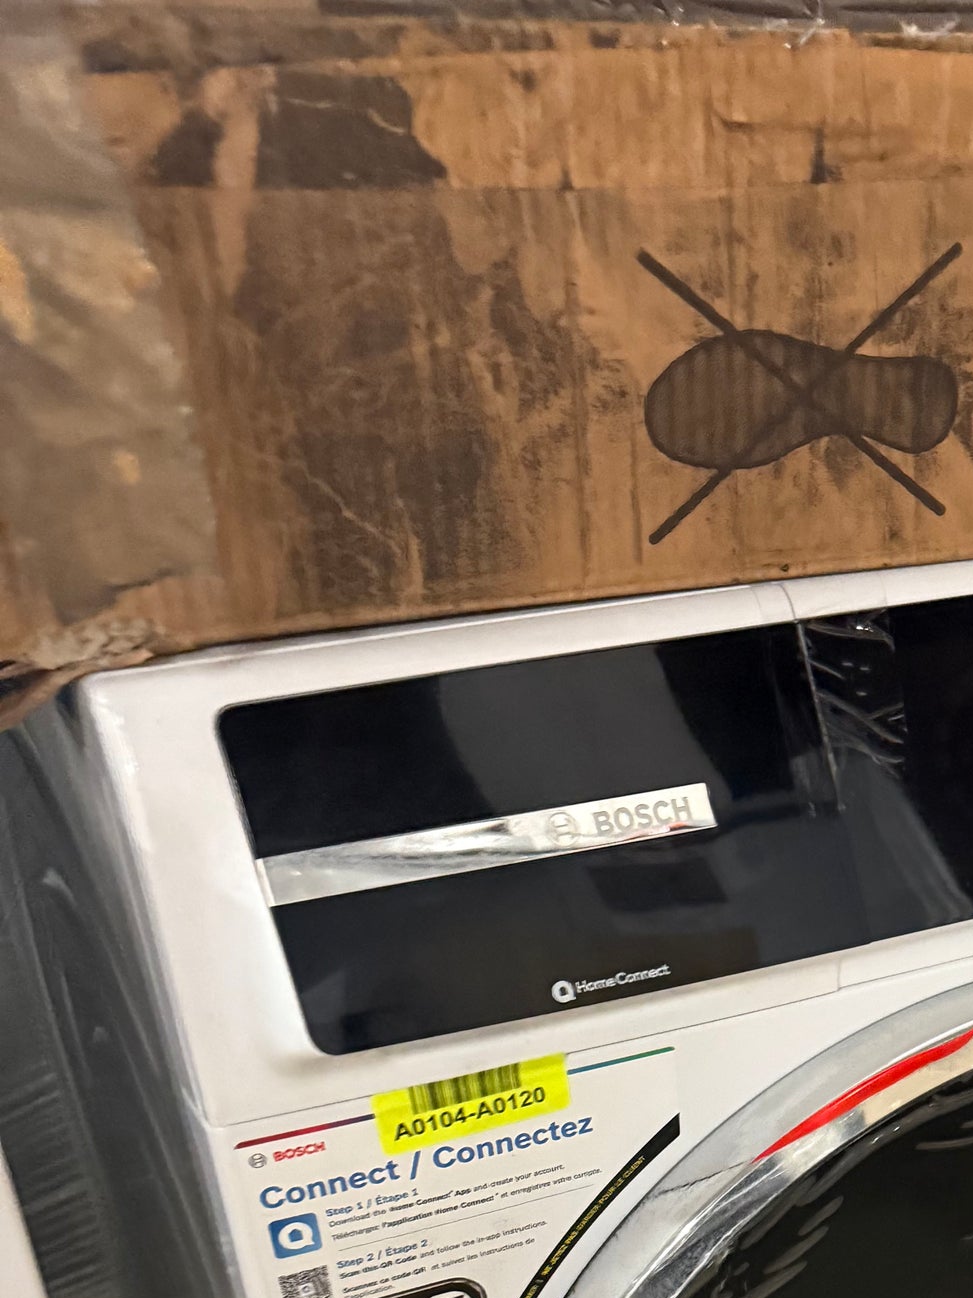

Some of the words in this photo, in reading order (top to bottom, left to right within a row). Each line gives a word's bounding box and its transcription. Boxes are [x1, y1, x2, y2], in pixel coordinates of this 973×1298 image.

[592, 796, 694, 836] BOSCH
[394, 1087, 546, 1141] A0104-A0120
[260, 1157, 400, 1210] Connect
[410, 1150, 421, 1180] /
[433, 1115, 594, 1172] Connectez
[273, 1141, 326, 1163] BOSCH
[326, 1205, 353, 1217] Step
[356, 1201, 363, 1210] 1
[412, 1188, 418, 1197] 1
[336, 1257, 364, 1269] Step
[366, 1253, 374, 1262] 2
[421, 1239, 428, 1248] 2
